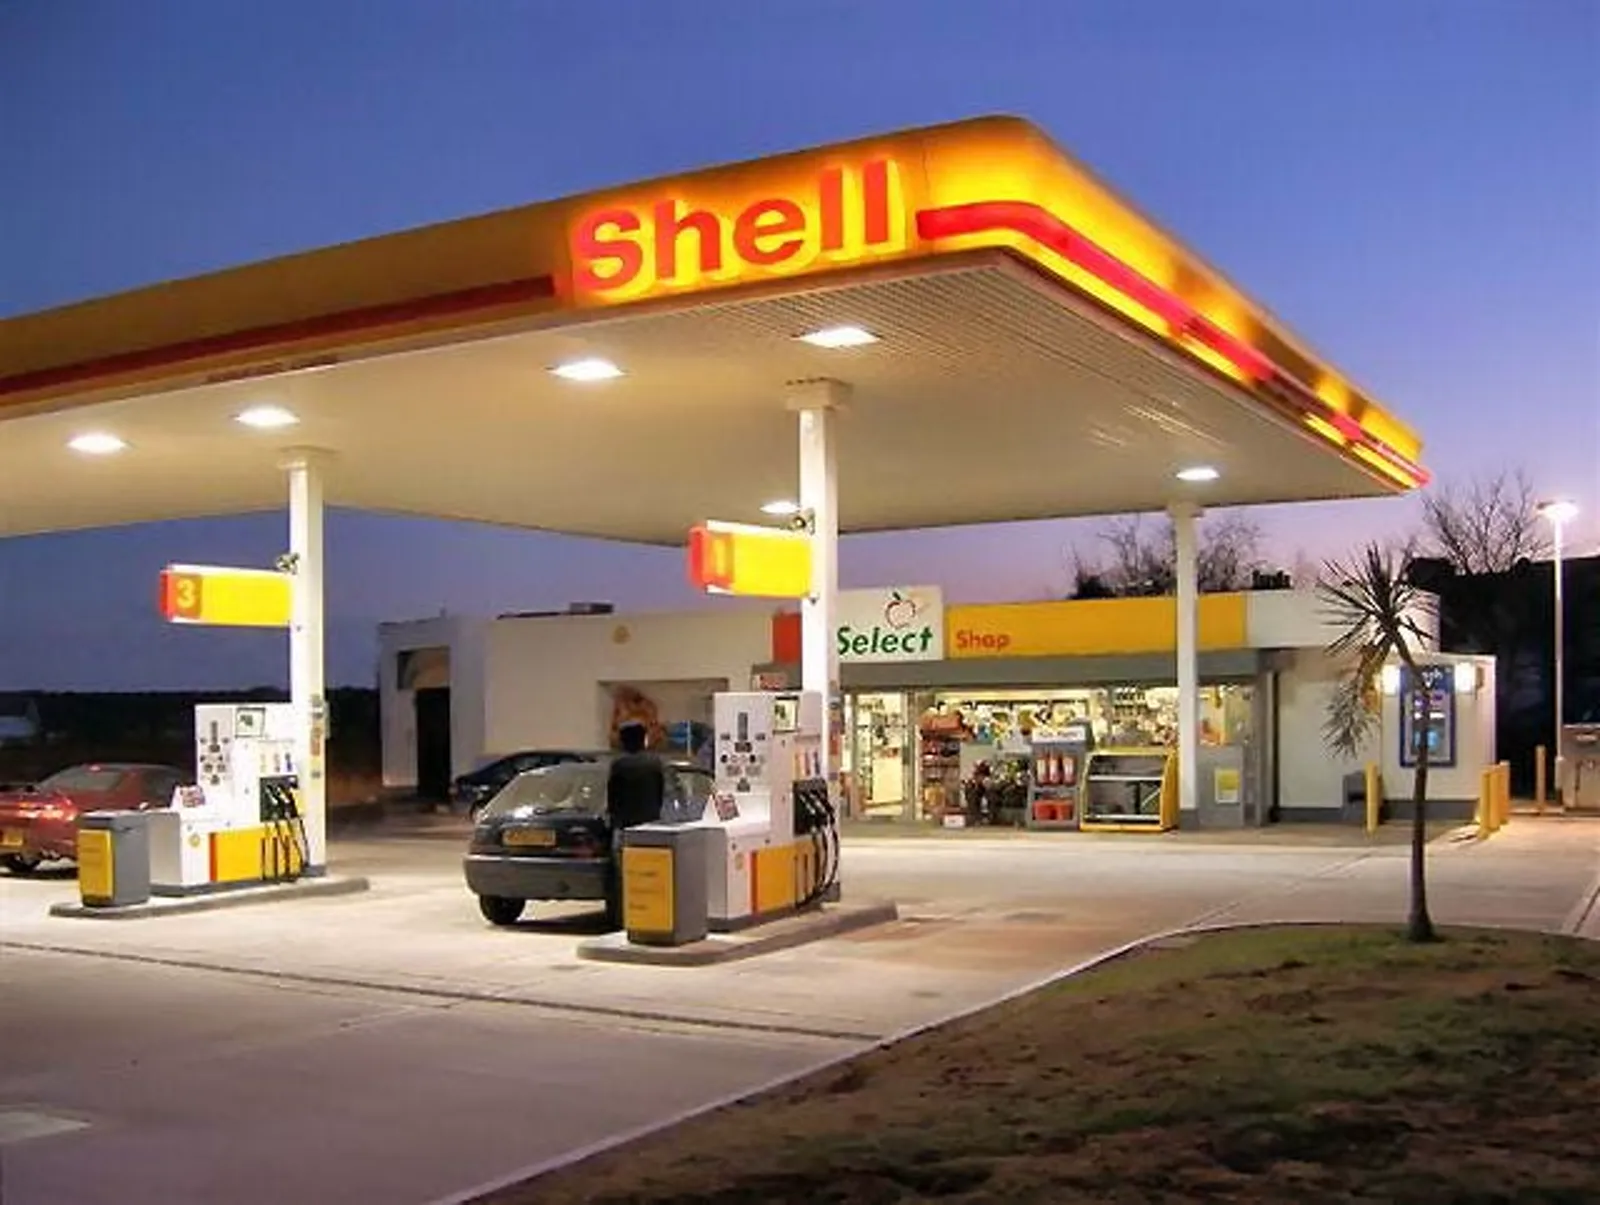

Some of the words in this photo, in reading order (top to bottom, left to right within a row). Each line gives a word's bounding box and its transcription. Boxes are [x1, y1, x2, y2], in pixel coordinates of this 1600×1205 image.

[571, 158, 889, 291] Shell
[176, 578, 197, 609] 3
[837, 627, 933, 655] Select
[956, 629, 1010, 652] Shop
